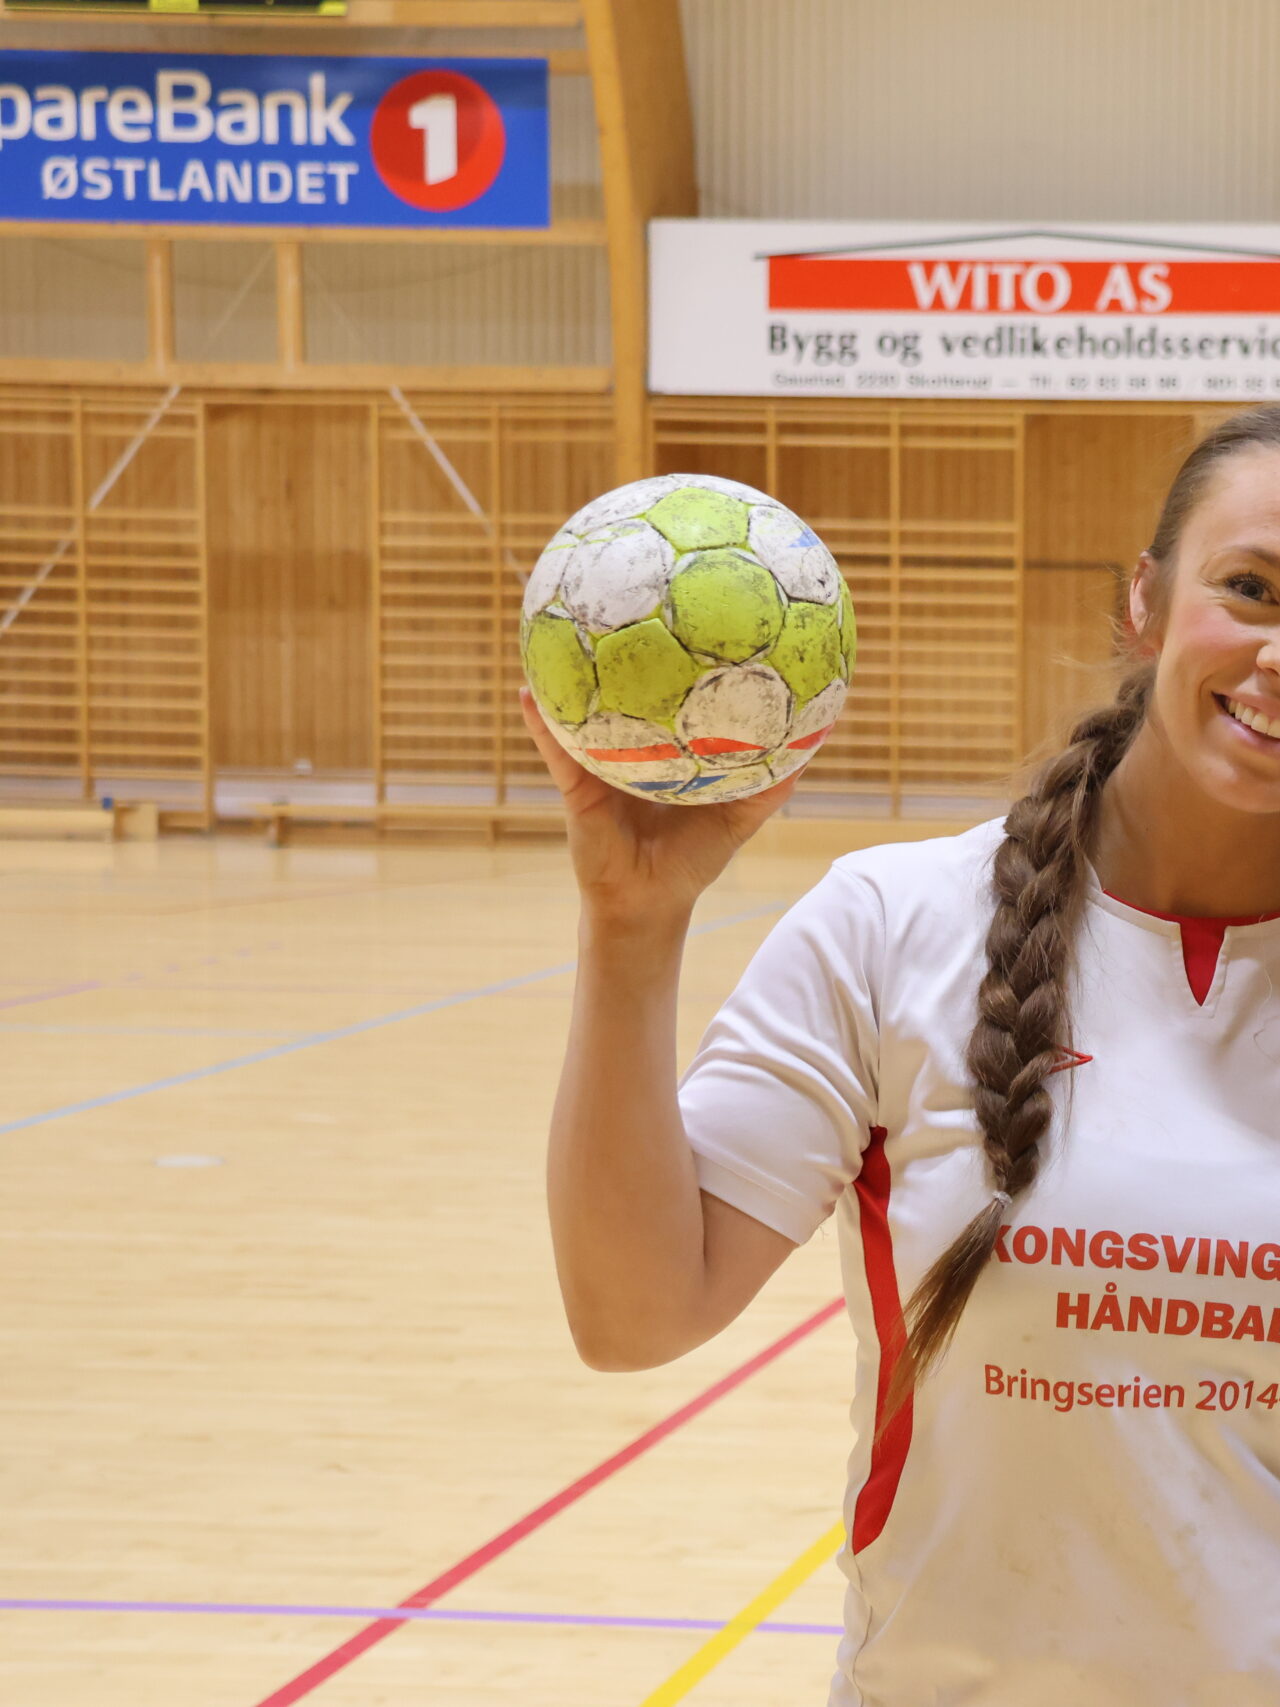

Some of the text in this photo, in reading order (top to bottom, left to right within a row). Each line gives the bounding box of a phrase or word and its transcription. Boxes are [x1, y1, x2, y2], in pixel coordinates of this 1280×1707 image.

[408, 93, 458, 186] 1
[41, 155, 359, 205] ØSTLANDET
[907, 261, 1173, 314] WITO AS
[768, 323, 858, 367] Bygg
[876, 332, 923, 367] og
[984, 1364, 1185, 1413] Bringserien
